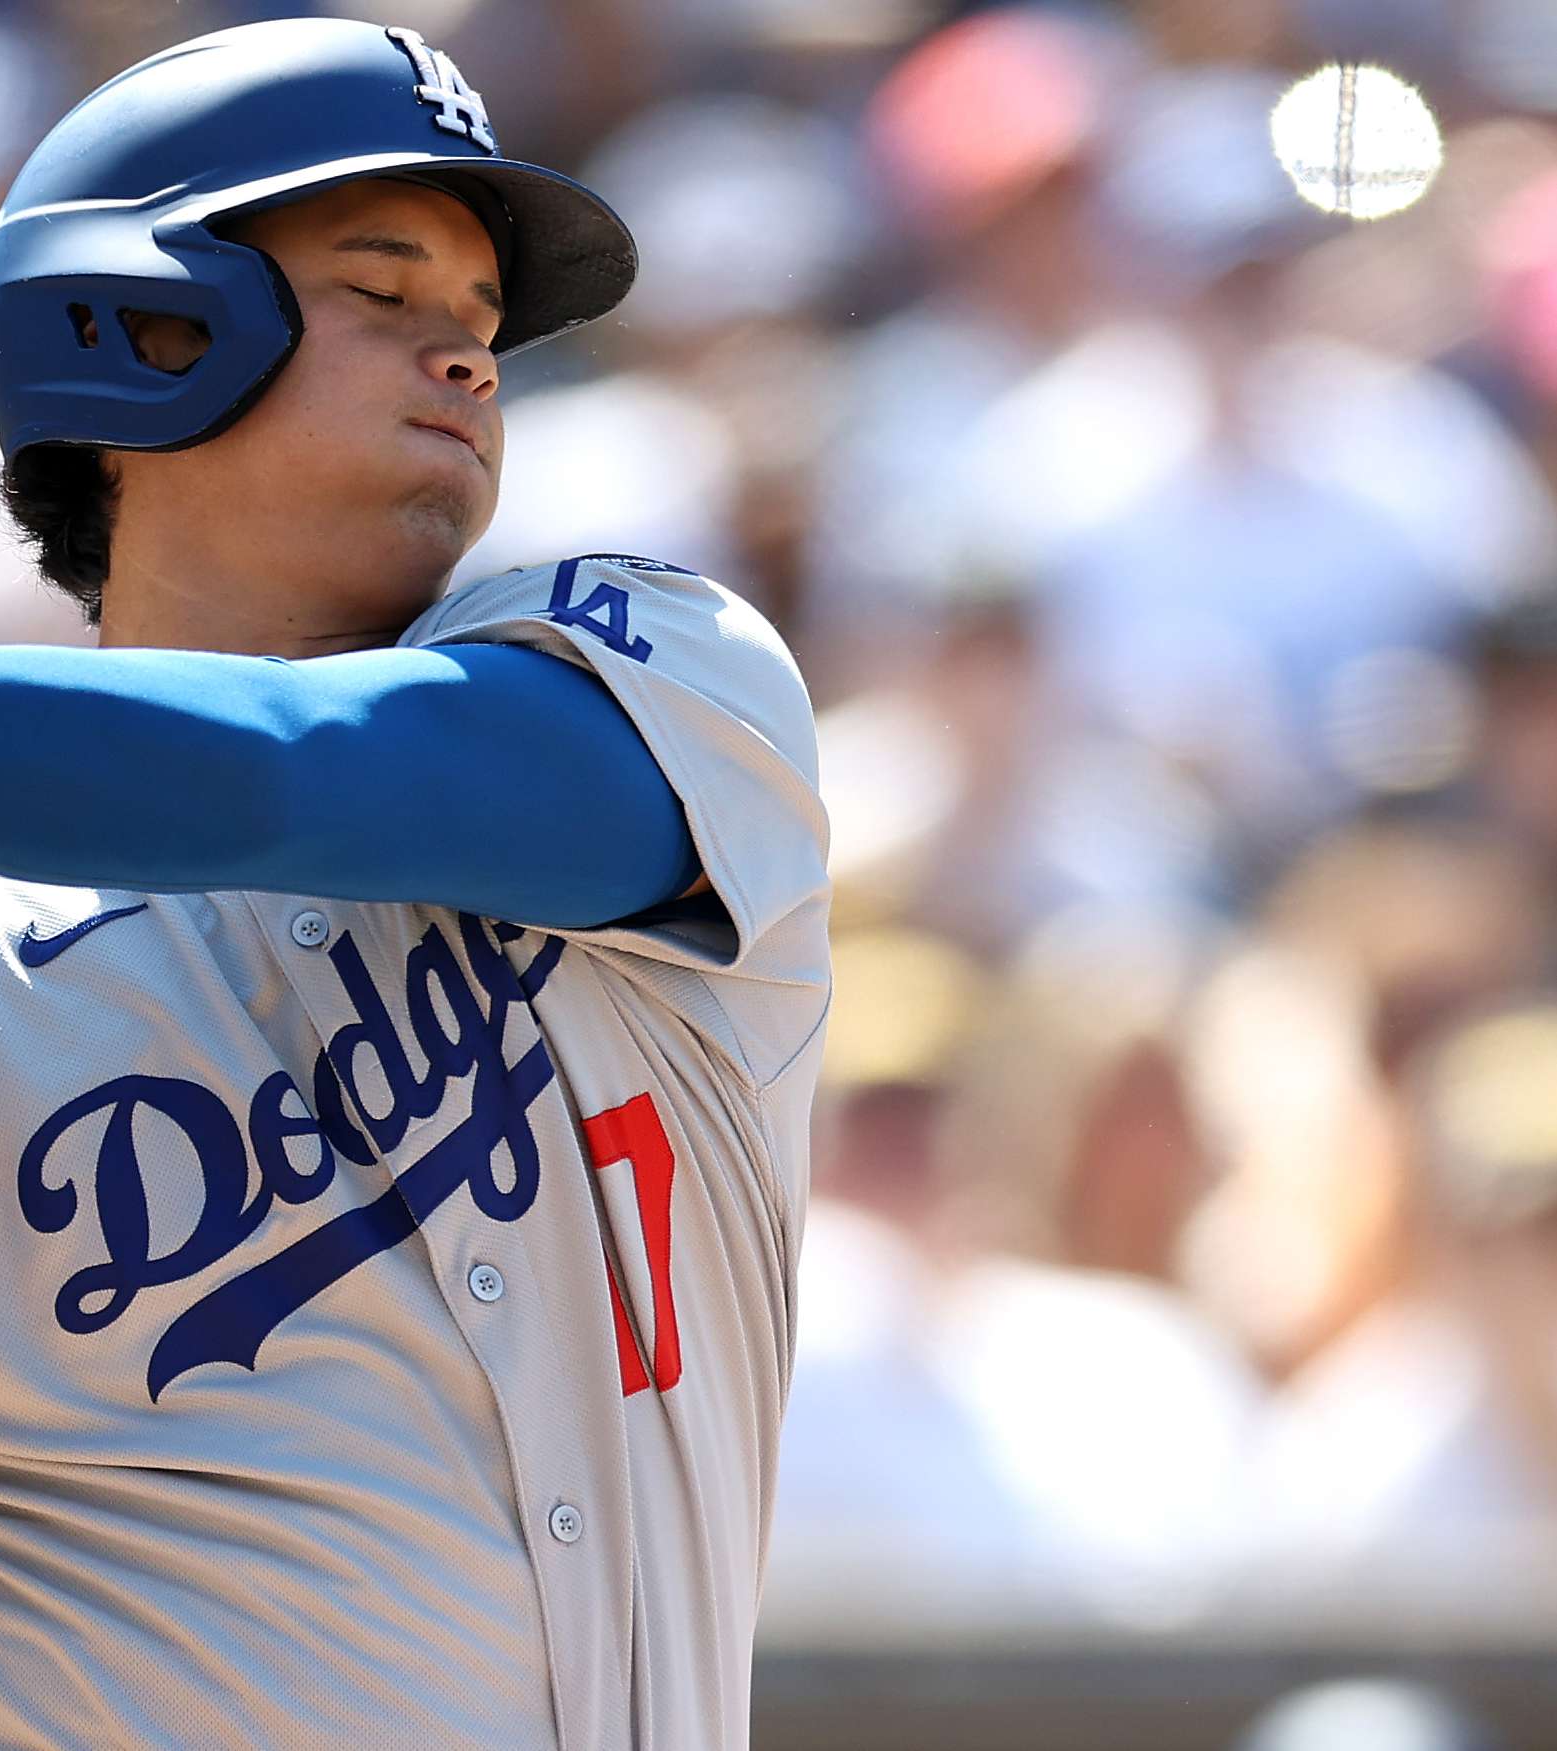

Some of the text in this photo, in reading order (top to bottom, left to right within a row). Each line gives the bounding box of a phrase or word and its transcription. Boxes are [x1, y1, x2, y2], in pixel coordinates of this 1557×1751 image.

[386, 26, 496, 154] LA
[548, 558, 653, 665] LA
[18, 908, 567, 1335] Dodge
